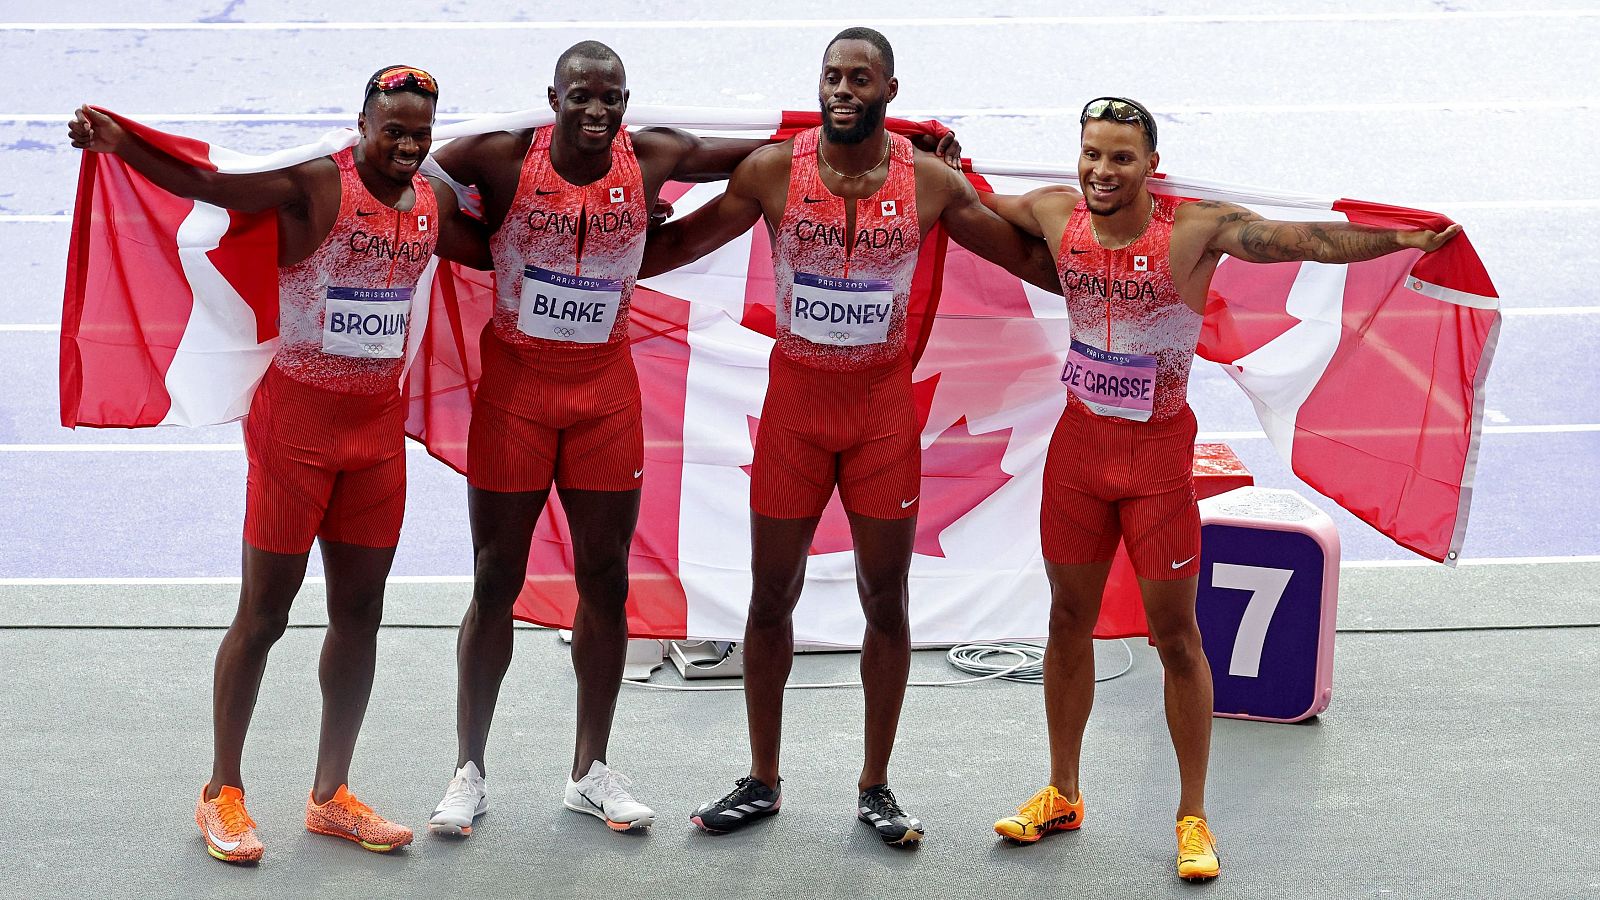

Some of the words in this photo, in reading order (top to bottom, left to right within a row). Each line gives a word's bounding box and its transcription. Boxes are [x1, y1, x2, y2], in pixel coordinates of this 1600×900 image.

[528, 210, 633, 235] CANADA
[796, 219, 904, 249] CANADA
[350, 230, 429, 262] CANADA
[551, 274, 576, 285] PARIS
[578, 280, 600, 288] 2024
[818, 278, 843, 288] PARIS
[1065, 269, 1156, 301] CANADA
[533, 293, 606, 322] BLAKE
[795, 296, 890, 324] RODNEY
[330, 312, 408, 336] BROWN
[1086, 348, 1105, 360] PARIS
[1107, 355, 1130, 364] 2024
[1061, 361, 1083, 387] DE
[1084, 370, 1152, 400] GRASSE
[1212, 563, 1294, 677] 7
[1034, 811, 1077, 834] NITRO
